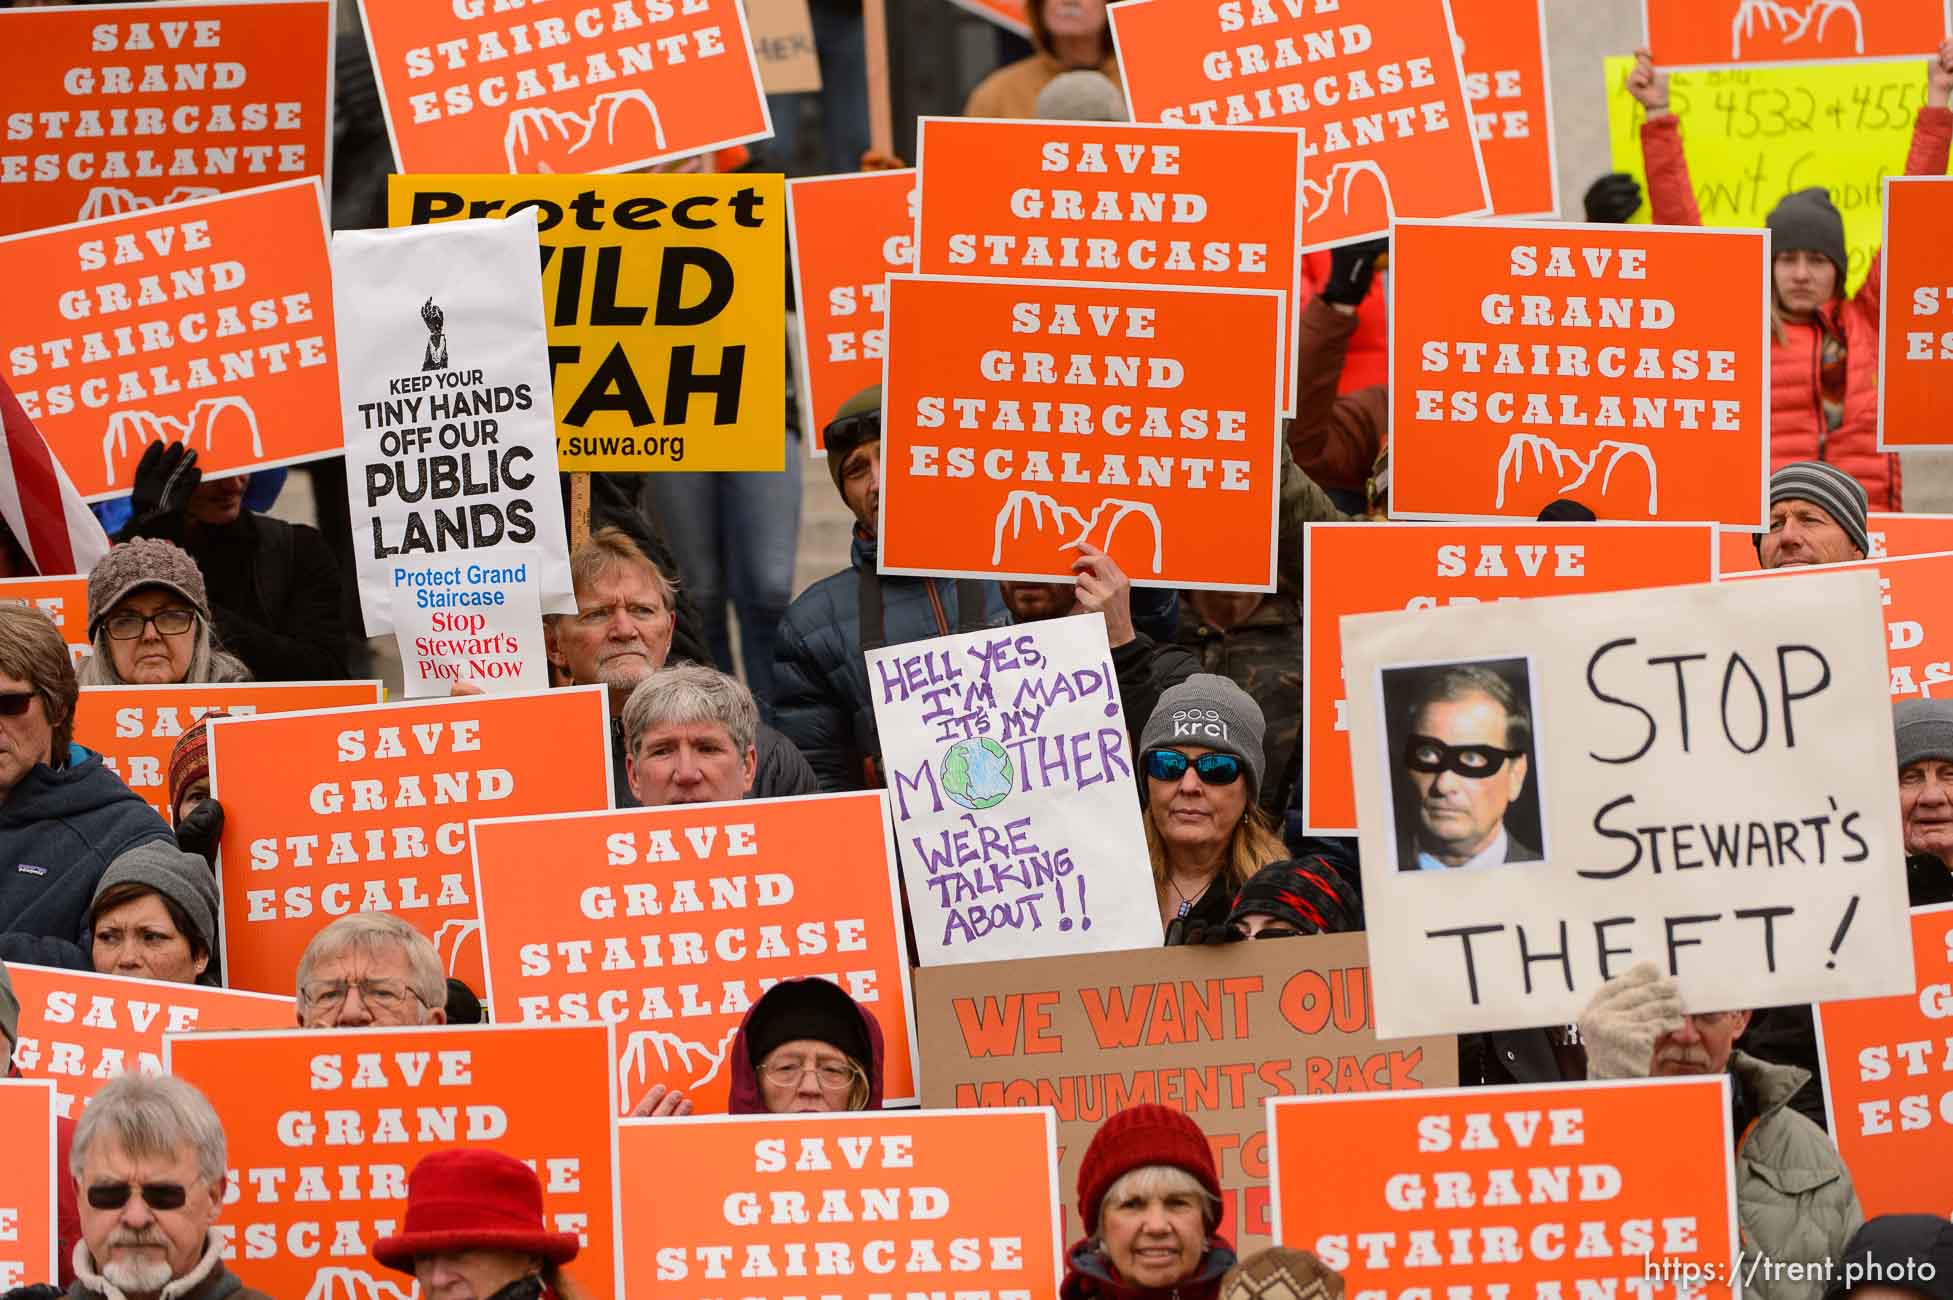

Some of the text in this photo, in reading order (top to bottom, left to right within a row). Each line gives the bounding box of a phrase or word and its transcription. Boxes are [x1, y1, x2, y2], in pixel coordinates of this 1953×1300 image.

[93, 21, 220, 51] SAVE
[1203, 24, 1372, 81] GRAND
[64, 63, 246, 95] GRAND
[405, 26, 726, 124] ESCALANTE
[1160, 57, 1436, 127] STAIRCASE
[8, 103, 300, 139] STAIRCASE
[1715, 88, 1815, 140] 4532
[0, 145, 305, 183] ESCALANTE
[1042, 142, 1179, 175] SAVE
[411, 187, 764, 230] Protect
[1011, 188, 1207, 223] GRAND
[78, 220, 211, 271] SAVE
[949, 234, 1266, 272] STAIRCASE
[1511, 246, 1646, 279] SAVE
[59, 261, 246, 320] GRAND
[540, 246, 735, 327] ILD
[1013, 303, 1155, 338] SAVE
[1481, 294, 1675, 329] GRAND
[10, 292, 313, 376] STAIRCASE
[15, 336, 327, 421] ESCALANTE
[390, 370, 483, 395] KEEP YOUR
[981, 351, 1184, 388] GRAND
[1422, 341, 1735, 381] STAIRCASE
[359, 384, 532, 429] TINY HANDS
[917, 397, 1245, 441] STAIRCASE
[1416, 390, 1740, 431] ESCALANTE
[381, 419, 498, 457] OFF OUR
[557, 436, 684, 461] .suwa.org
[366, 445, 534, 508] PUBLIC
[910, 446, 1249, 490] ESCALANTE
[372, 499, 535, 559] LANDS
[394, 564, 526, 586] Protect Grand
[1437, 545, 1584, 577] SAVE
[416, 588, 504, 608] Staircase
[416, 636, 519, 656] Stewart's
[432, 613, 486, 638] Stop
[419, 659, 523, 683] Ploy Now
[876, 635, 1047, 705] HELL YES,
[921, 661, 1120, 725] I'M MAD!
[1172, 708, 1220, 722] 90.9
[1587, 638, 1830, 764] STOP
[115, 705, 257, 737] SA
[337, 720, 480, 762] SAVE
[935, 703, 1045, 743] IT'S MY
[1174, 719, 1228, 742] krcl
[310, 769, 514, 814] GRAND
[250, 823, 465, 870] STAIRC
[606, 822, 758, 866] SAVE
[911, 813, 1040, 875] WE'RE
[1578, 795, 1868, 879] STEWART'S
[246, 873, 470, 922] ESCALA
[580, 873, 794, 920] GRAND
[926, 847, 1074, 908] TALKING
[520, 918, 867, 977] STAIRCASE
[43, 990, 198, 1032] SAVE
[518, 970, 879, 1026] ESCALAE
[953, 967, 1375, 1056] WE WANT OU
[12, 1036, 163, 1080] GRAN
[310, 1051, 472, 1090] SAVE
[956, 1046, 1424, 1123] MONUMENTS BACK
[277, 1105, 507, 1147] GRAND
[1418, 1108, 1584, 1152] SAVE
[754, 1135, 914, 1173] SAVE
[723, 1186, 950, 1226] GRAND
[1385, 1164, 1622, 1211] GRAND
[656, 1236, 1023, 1281] STAIRCASE
[1315, 1216, 1698, 1272] STAIRCASE
